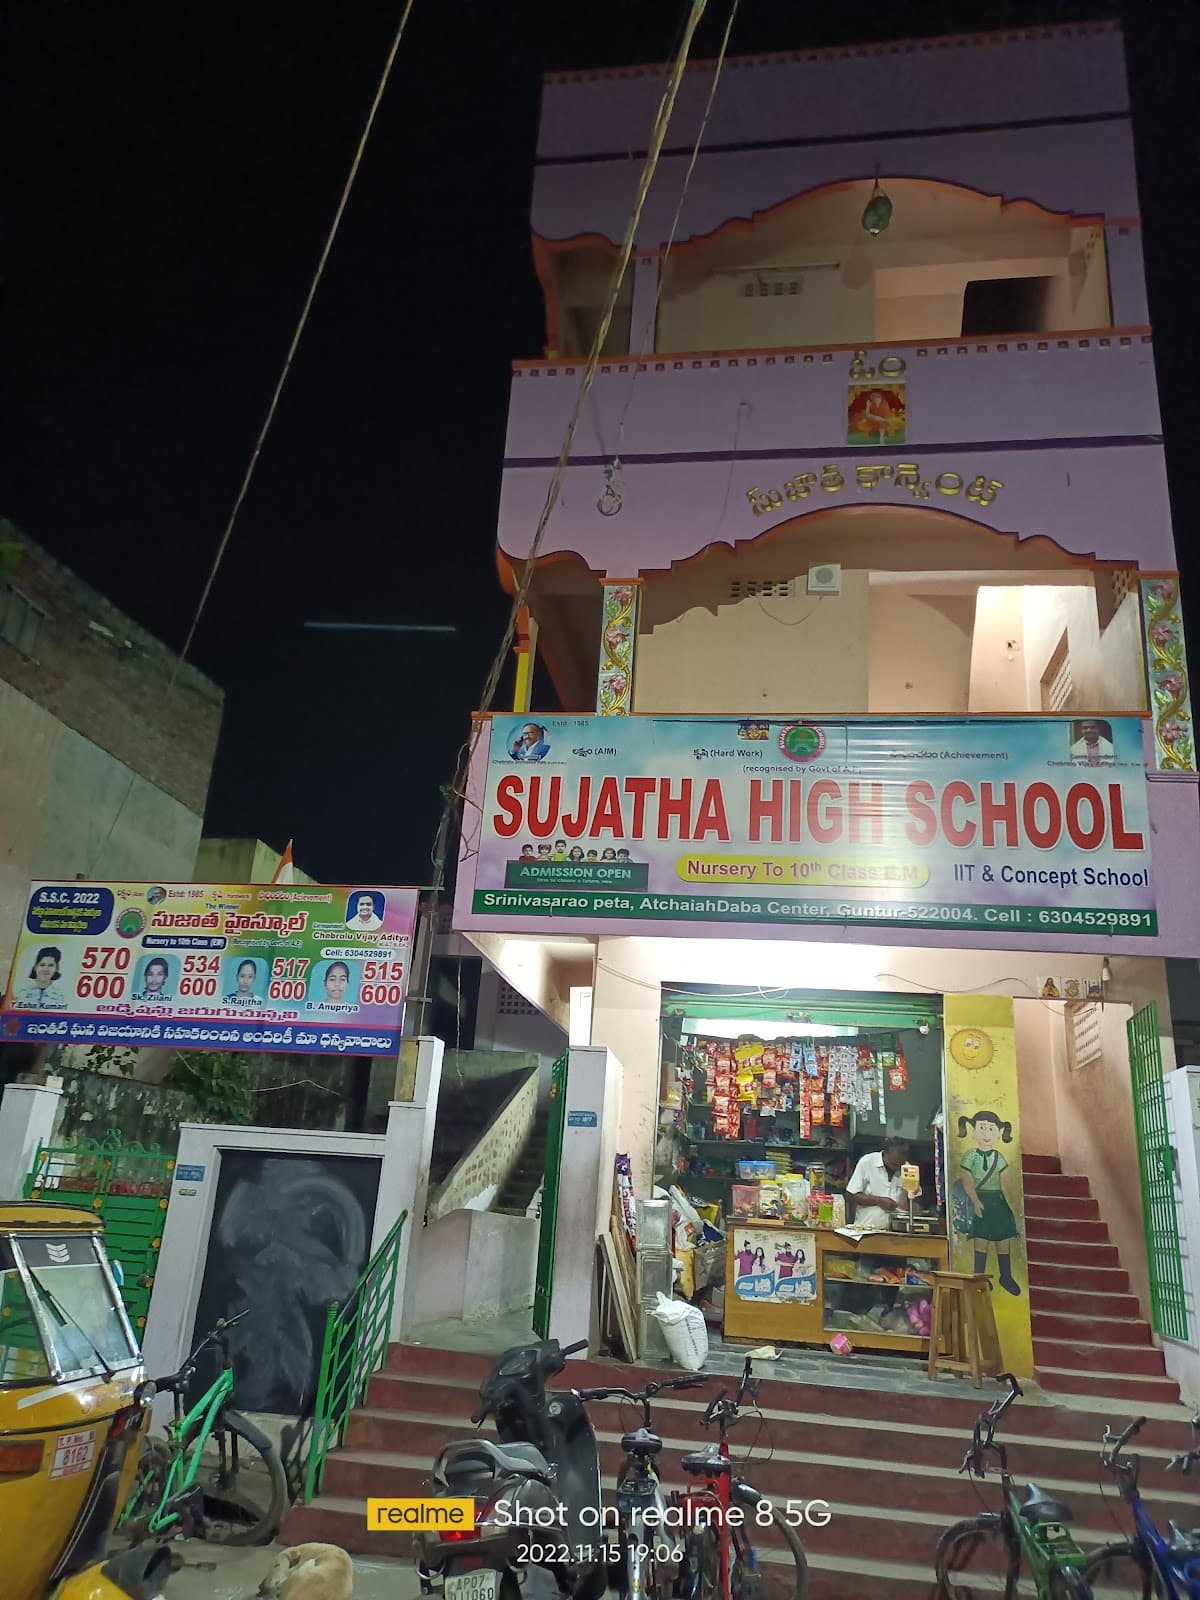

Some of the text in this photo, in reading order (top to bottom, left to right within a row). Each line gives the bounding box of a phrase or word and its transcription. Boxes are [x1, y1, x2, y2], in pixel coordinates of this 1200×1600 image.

[594, 747, 617, 756] (AIM)
[710, 748, 735, 758] (Hard
[737, 748, 764, 758] Work)
[940, 751, 1009, 761] (Achievement)
[743, 765, 795, 775] (recognised
[796, 765, 806, 775] by
[492, 774, 1146, 851] SUJATHA HIGH SCHOOL
[520, 866, 632, 879] ADMISSION OPEN
[687, 859, 756, 880] Nursery
[763, 861, 784, 876] To
[789, 861, 822, 878] 10th
[827, 862, 880, 879] Class
[953, 864, 1149, 889] IIT & Concept School
[39, 892, 100, 904] S.S.C. 2022
[484, 892, 588, 908] Srinivasarao
[593, 897, 634, 912] peta,
[639, 897, 762, 914] AtchaiahDaba
[767, 901, 831, 918] Center,
[836, 903, 978, 921] Guntur-522004.
[984, 908, 1021, 923] Cell
[1038, 910, 1152, 927] 6304529891
[151, 910, 219, 928] సుజాత
[224, 912, 308, 936] హైస్కూల్
[356, 933, 379, 942] Vijay
[380, 933, 409, 942] Aditya
[81, 947, 131, 970] 570
[325, 949, 392, 958] Cell: 6304529891
[183, 955, 220, 973] 534
[272, 958, 309, 977] 517
[363, 961, 403, 981] 515
[76, 975, 125, 999] 600
[179, 978, 217, 996] 600
[269, 981, 305, 1000] 600
[361, 985, 401, 1004] 600
[318, 1003, 359, 1013] Anupriya
[295, 1031, 318, 1045] మా
[320, 1033, 392, 1052] ధన్యవాదాలు
